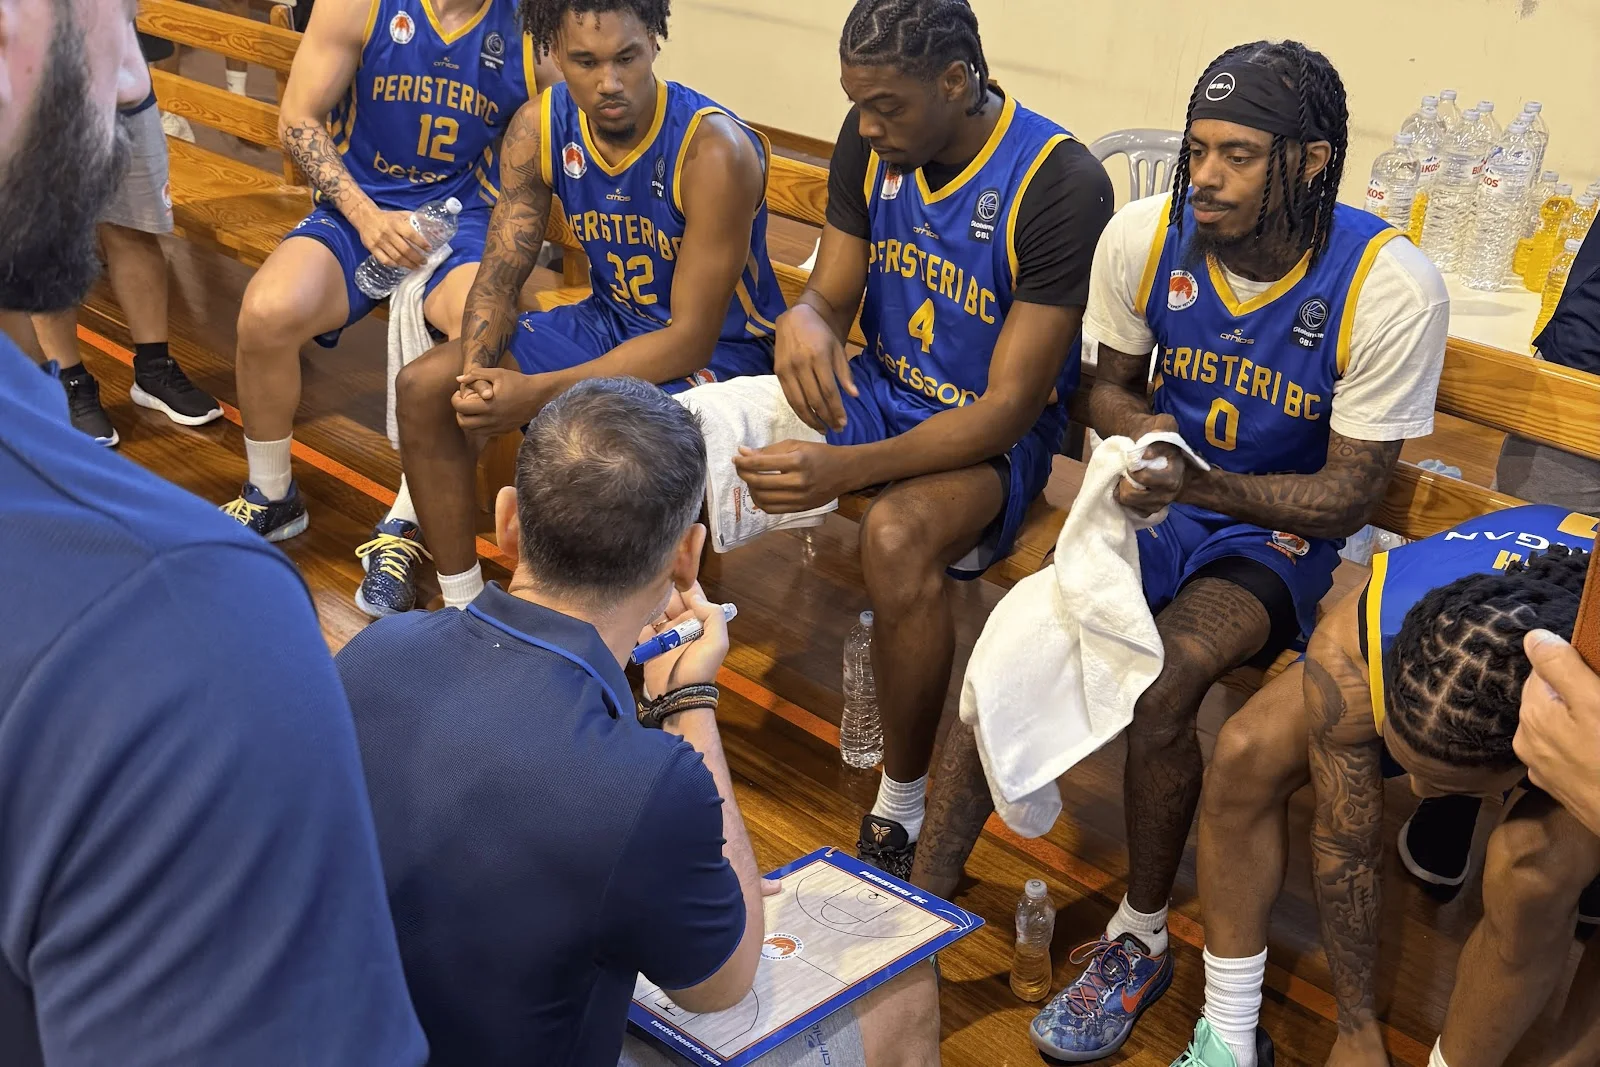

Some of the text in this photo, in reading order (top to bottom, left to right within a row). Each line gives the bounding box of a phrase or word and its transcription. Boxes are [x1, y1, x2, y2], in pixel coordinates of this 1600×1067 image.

[416, 113, 460, 163] 12
[974, 230, 990, 240] GBL
[606, 250, 658, 305] 32
[963, 275, 996, 325] BC
[908, 297, 935, 353] 4
[1298, 336, 1314, 347] GBL
[1161, 346, 1321, 421] ERISTERI BC
[1205, 396, 1240, 451] 0
[859, 870, 929, 905] PERISTERI BC
[650, 1020, 722, 1067] tactic-boards.com
